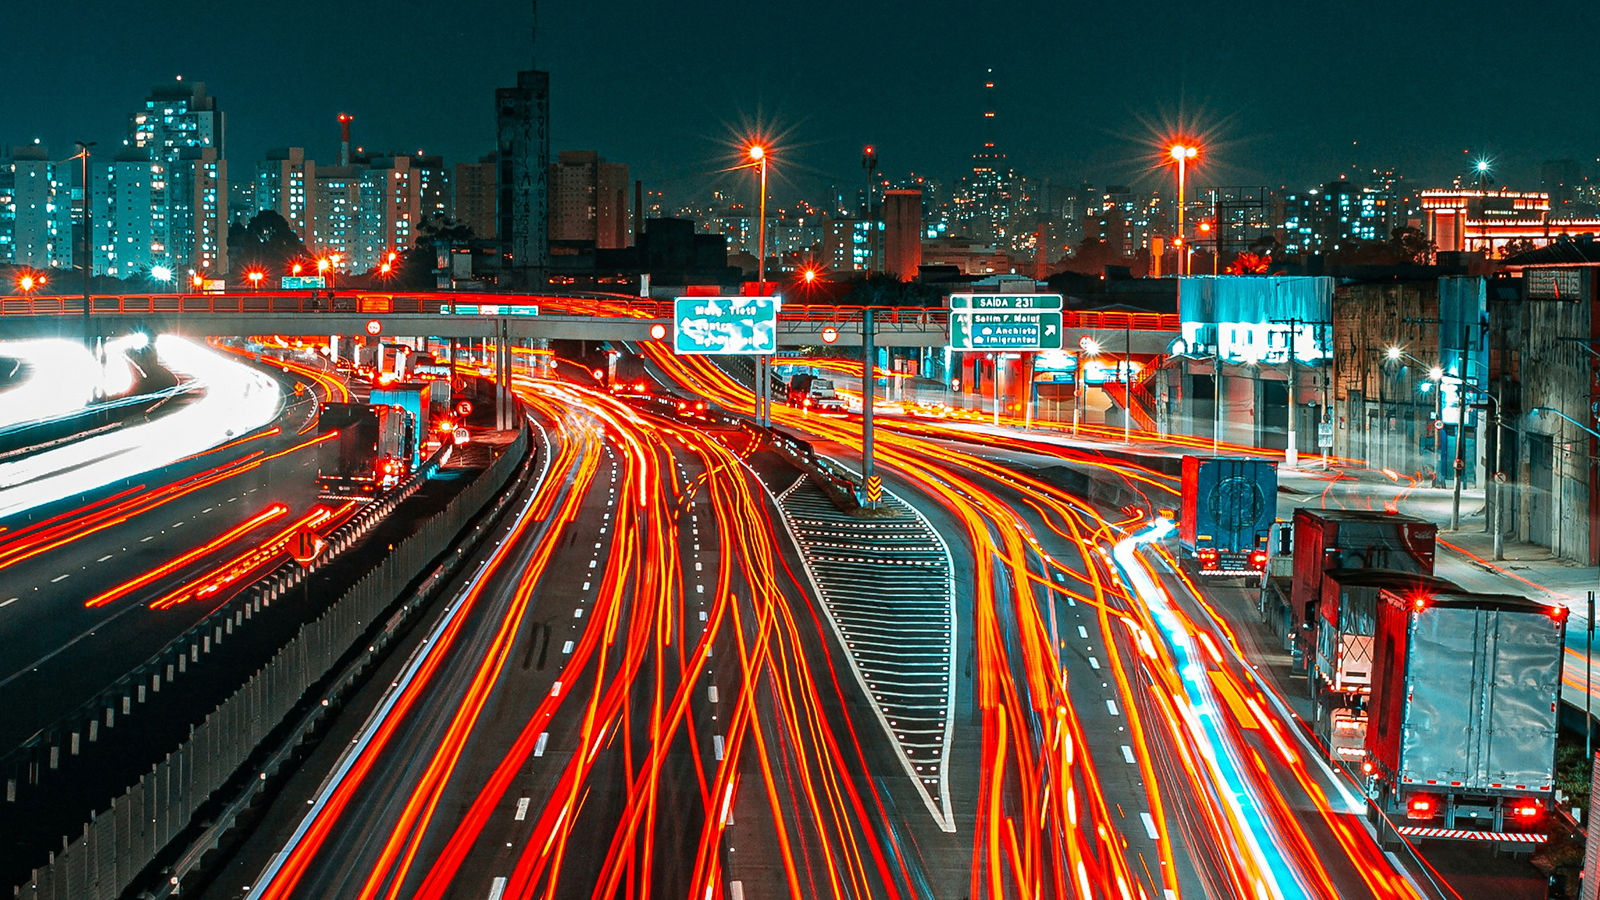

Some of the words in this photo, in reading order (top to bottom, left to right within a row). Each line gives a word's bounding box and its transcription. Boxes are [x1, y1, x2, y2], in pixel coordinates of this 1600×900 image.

[1015, 298, 1034, 307] 231
[975, 314, 1001, 323] Salim
[1014, 314, 1040, 323] Maluf
[995, 327, 1037, 335] Anchieta
[986, 336, 1037, 345] Imigrantes
